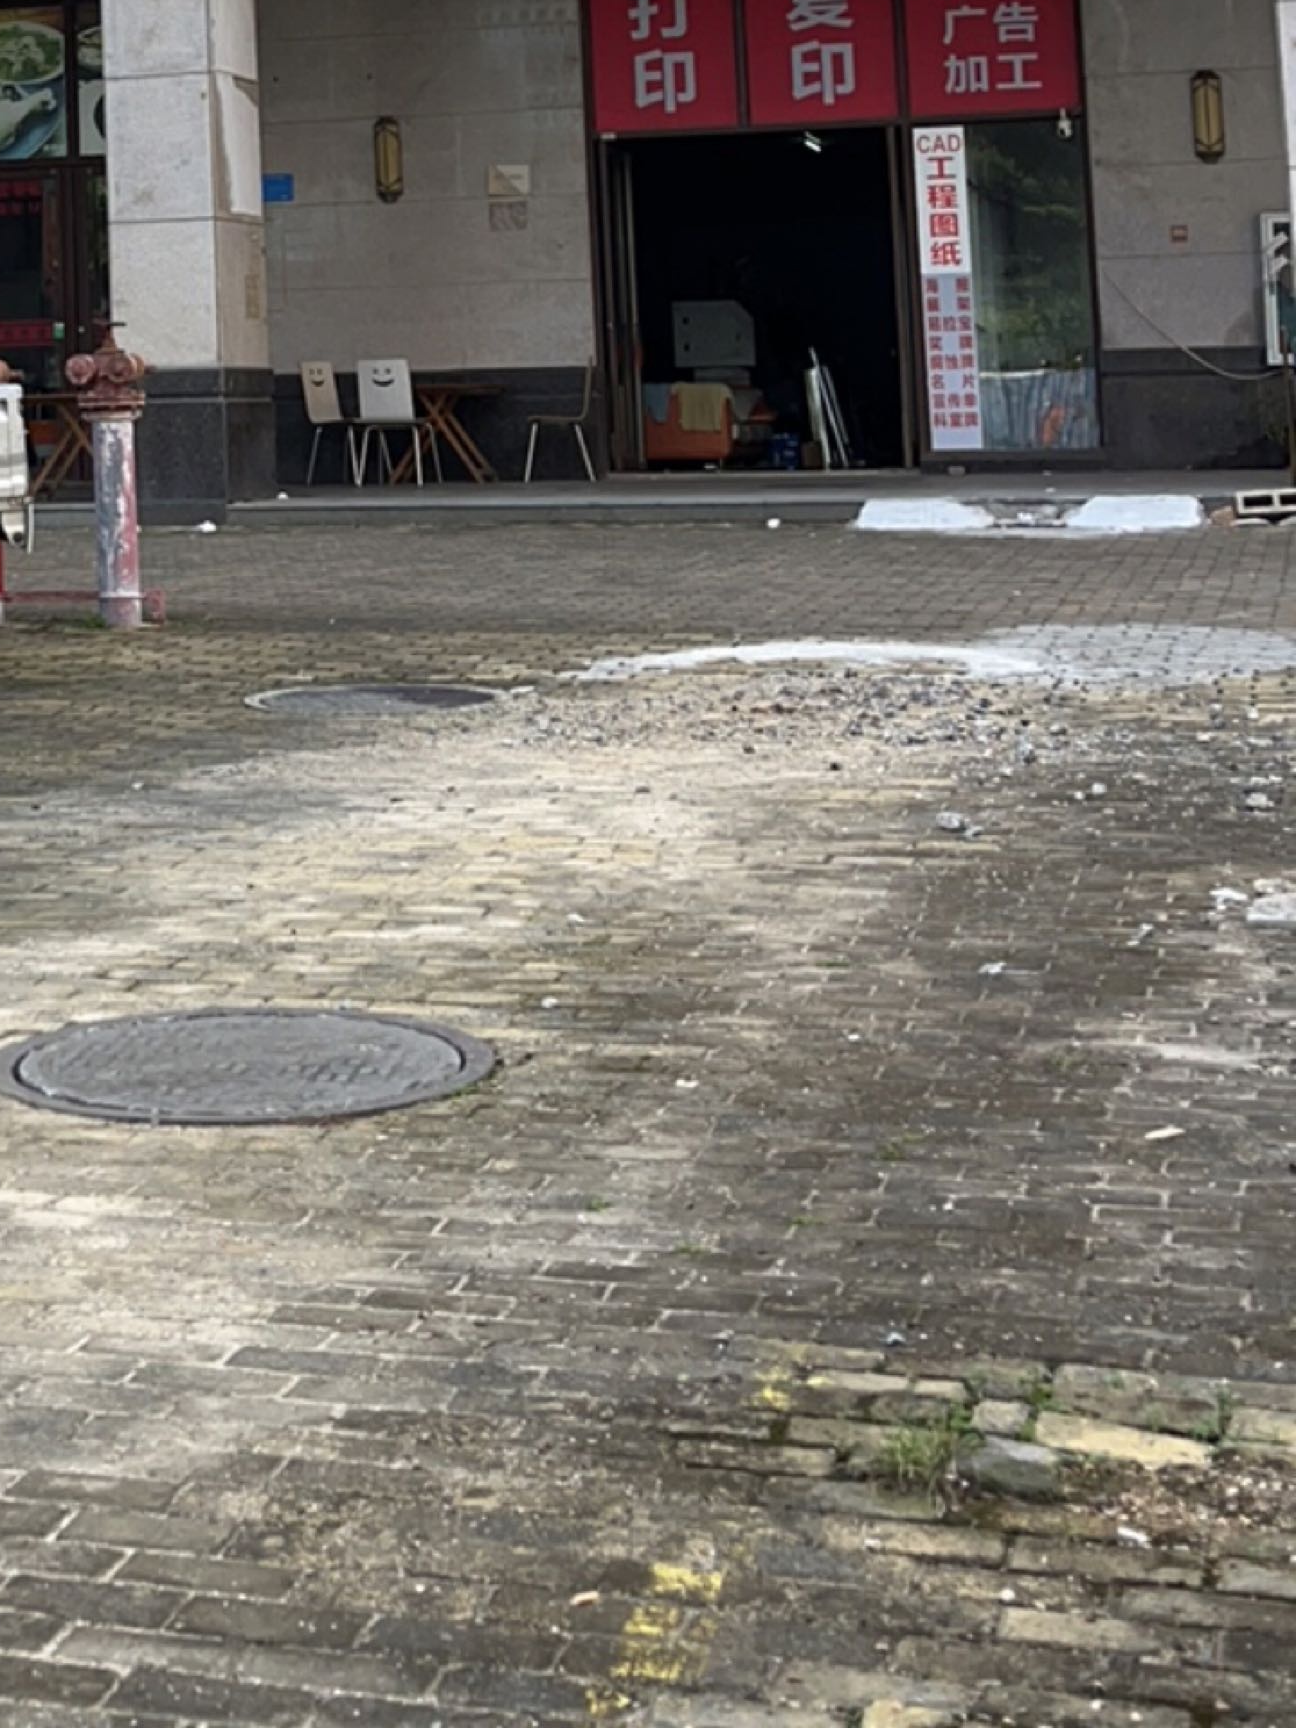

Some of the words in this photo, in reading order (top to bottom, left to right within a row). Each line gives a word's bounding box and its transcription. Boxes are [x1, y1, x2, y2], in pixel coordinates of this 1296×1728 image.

[943, 4, 1040, 46] 广告
[943, 51, 1044, 94] 加工
[916, 133, 962, 154] CAD
[926, 157, 962, 267] 工程图纸
